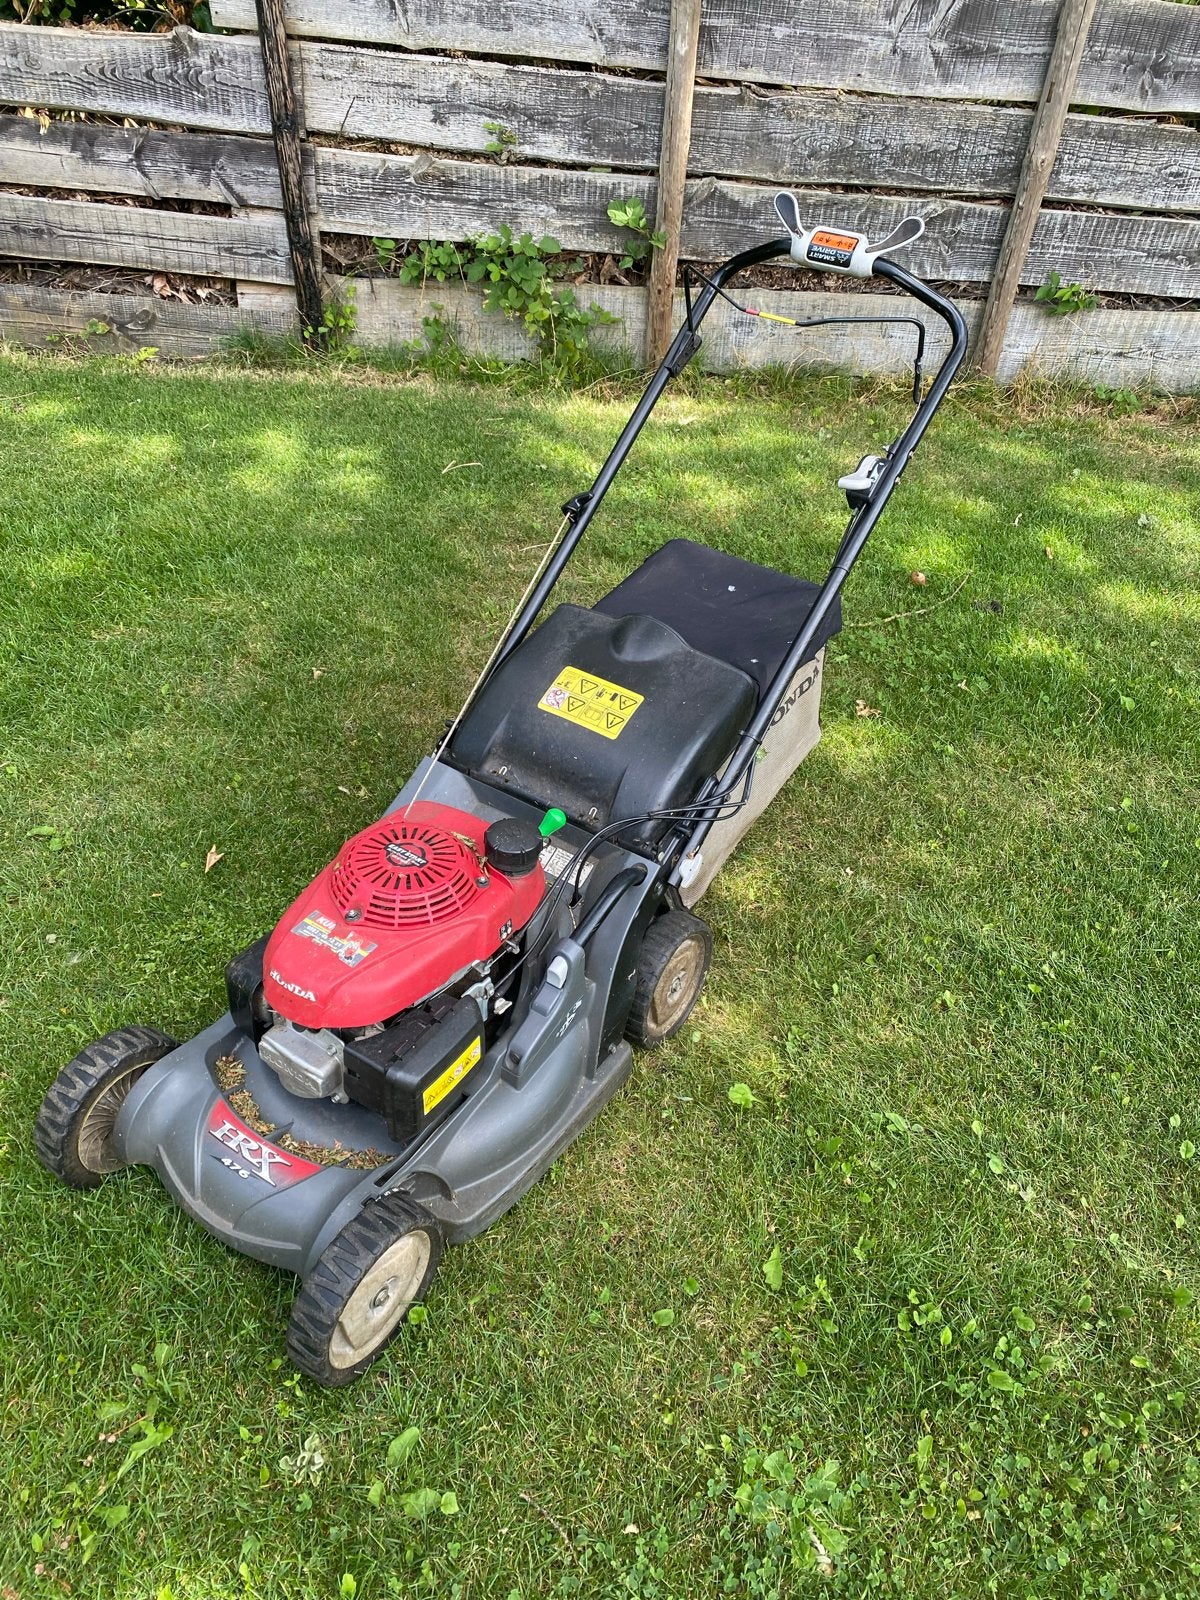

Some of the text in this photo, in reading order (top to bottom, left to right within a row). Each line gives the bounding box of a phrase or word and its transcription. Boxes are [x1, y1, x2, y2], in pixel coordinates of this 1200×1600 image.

[808, 251, 837, 262] SMART
[811, 245, 837, 256] DRIVE
[769, 665, 819, 727] ONDA
[270, 968, 317, 1002] HONDA
[208, 1119, 293, 1187] HRX
[221, 1158, 251, 1179] 476
